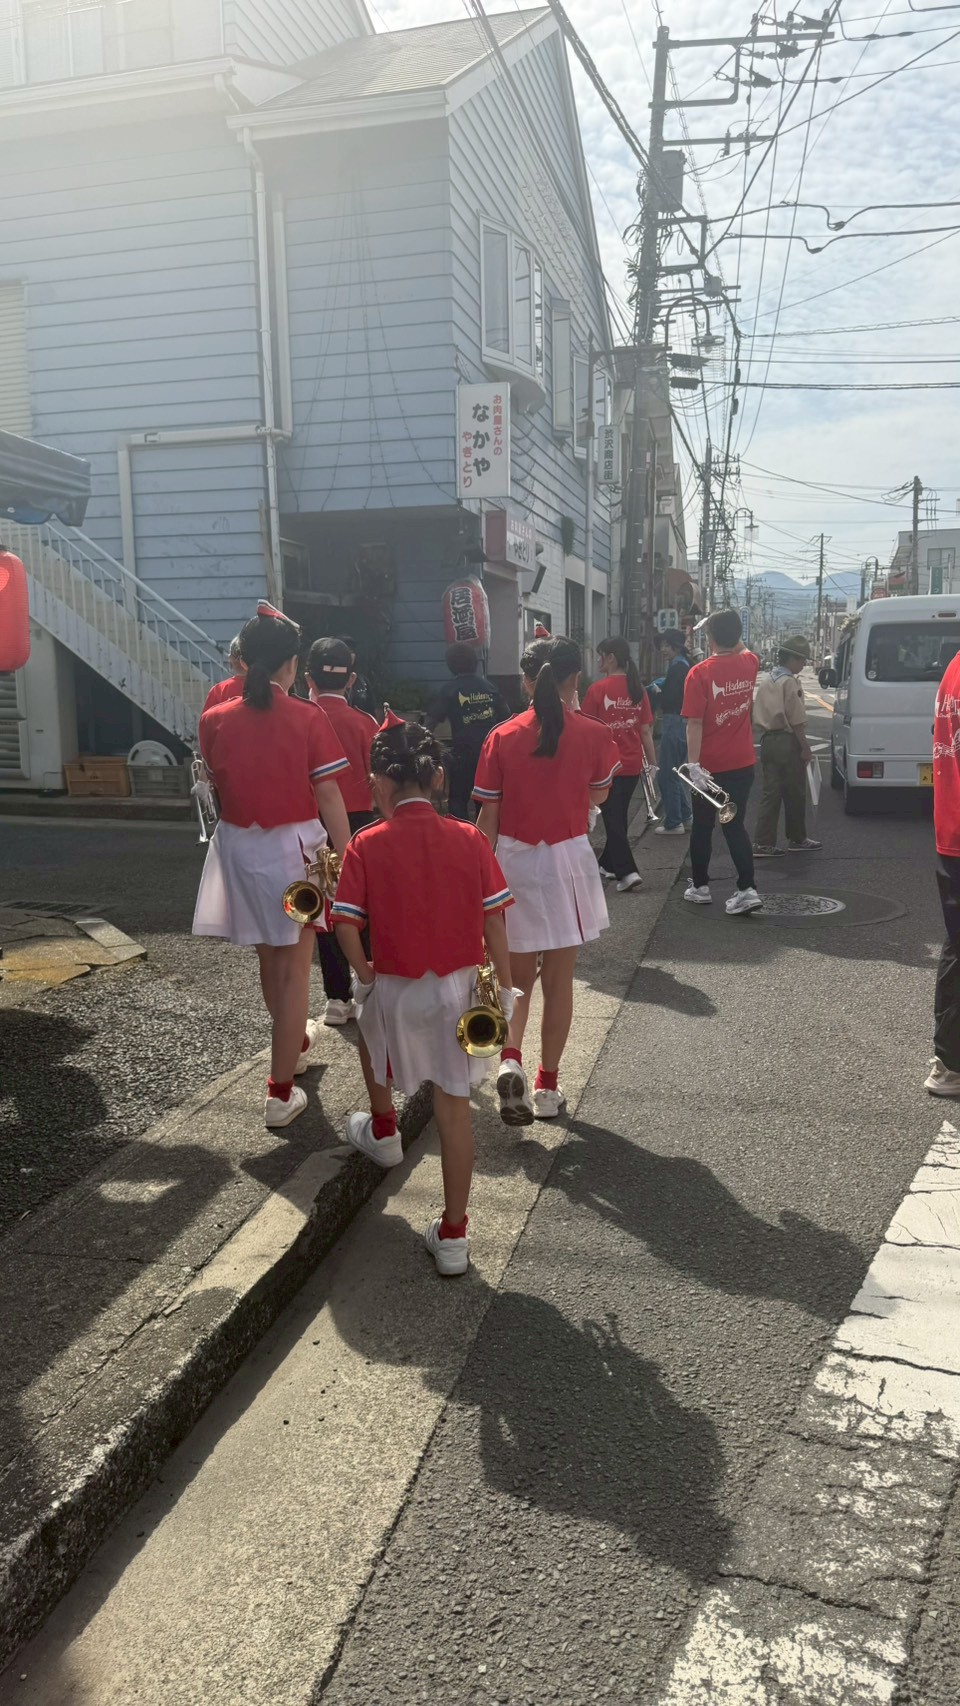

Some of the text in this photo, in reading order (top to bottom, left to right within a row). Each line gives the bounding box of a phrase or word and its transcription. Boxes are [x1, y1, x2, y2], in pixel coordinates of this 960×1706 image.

[472, 403, 491, 477] なかや
[493, 394, 503, 456] お肉屋さんの
[462, 431, 473, 488] やきとり
[604, 429, 614, 480] 渋沢商店街
[450, 587, 479, 641] 居酒屋
